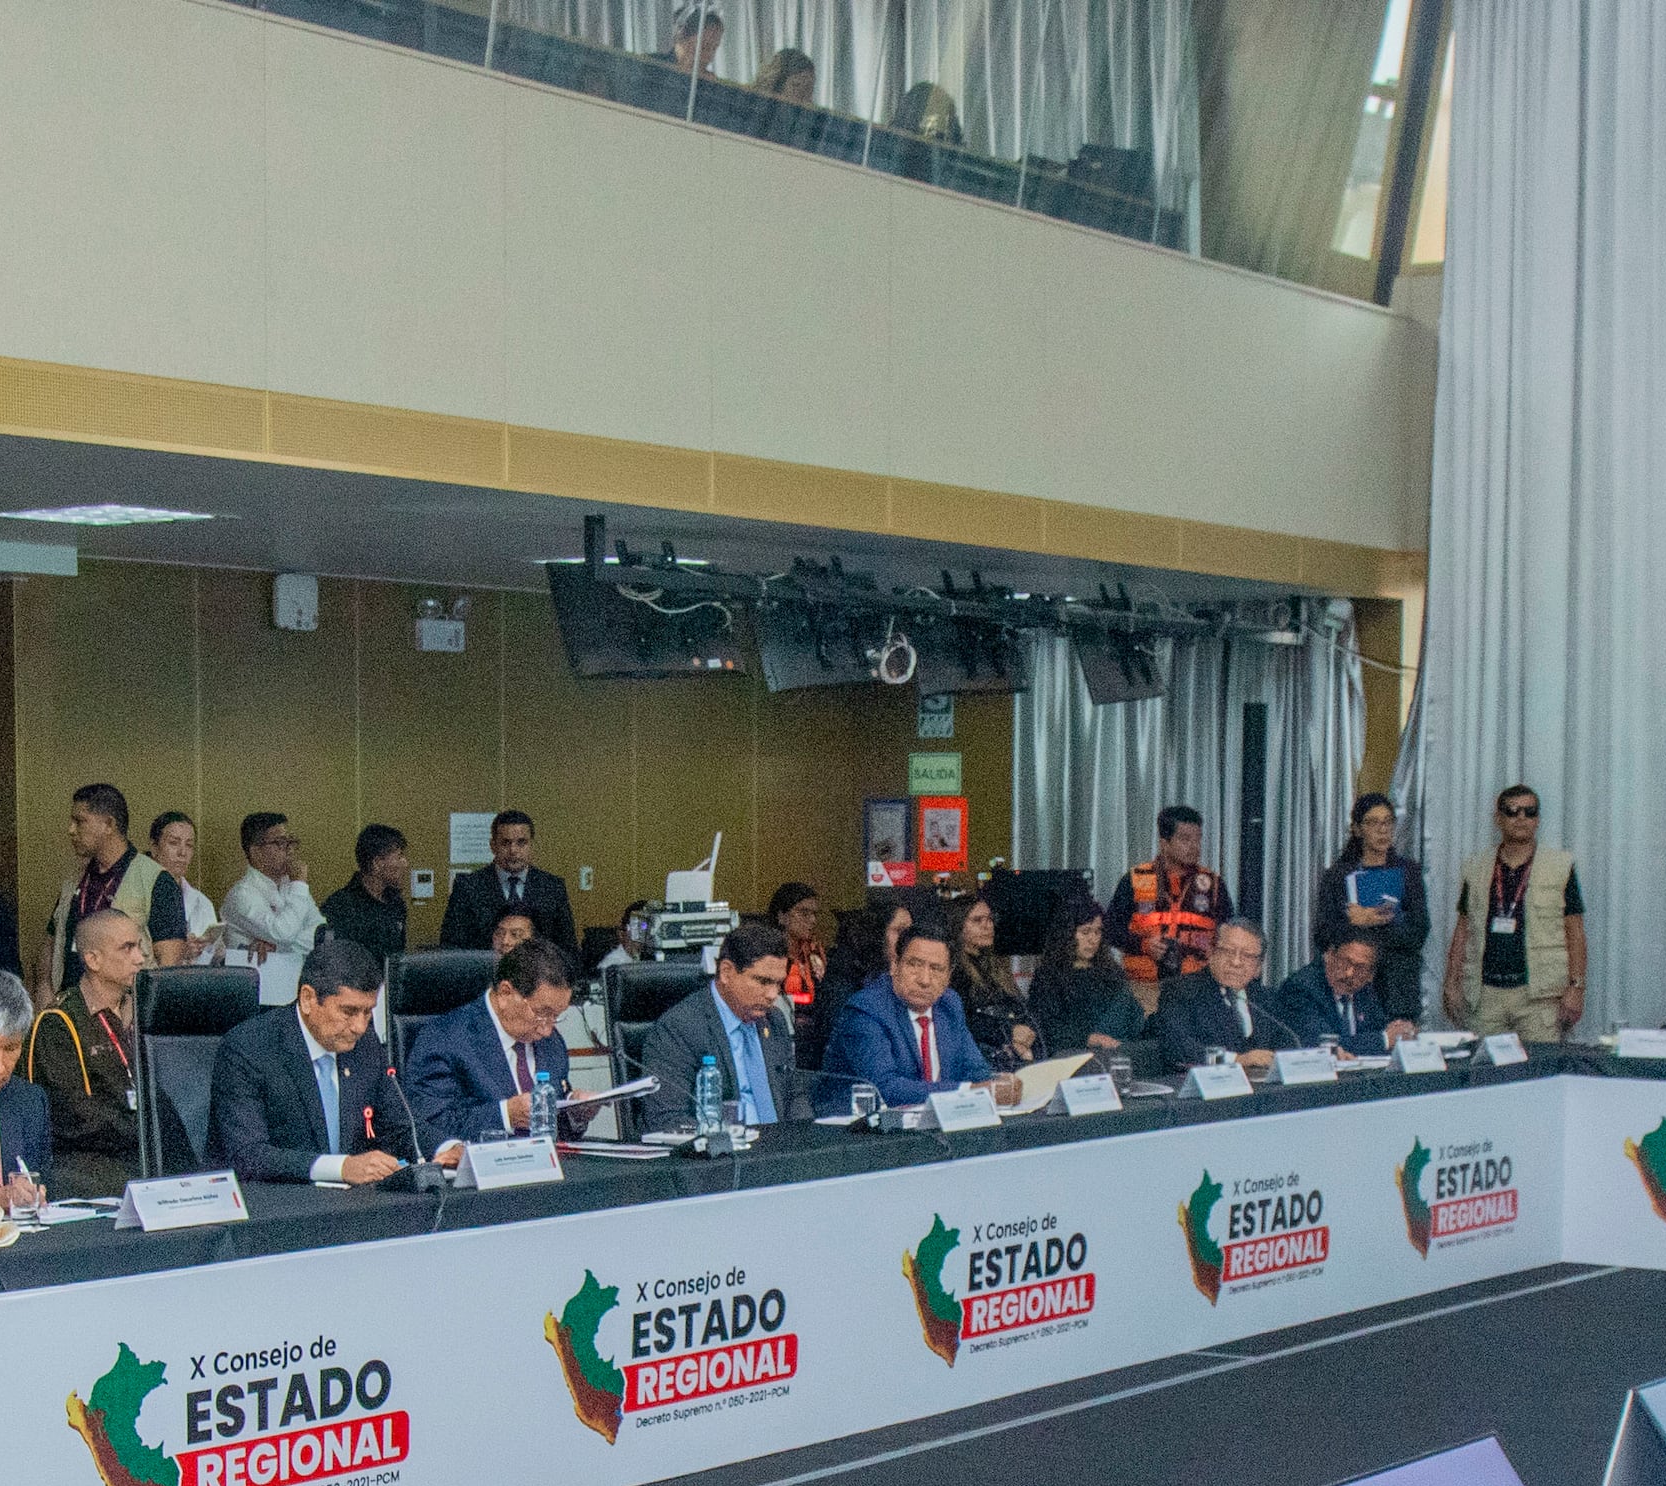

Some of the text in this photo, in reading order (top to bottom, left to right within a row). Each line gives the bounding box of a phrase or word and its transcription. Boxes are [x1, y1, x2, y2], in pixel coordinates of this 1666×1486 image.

[913, 767, 956, 780] SALIDA
[1436, 1155, 1512, 1200] ESTADO
[973, 1212, 1057, 1244] X Consejo de
[1229, 1189, 1324, 1240] ESTADO
[1438, 1191, 1516, 1235] REGIONAL
[968, 1232, 1087, 1292] ESTADO
[1232, 1229, 1326, 1277] REGIONAL
[636, 1267, 745, 1303] X Consejo de
[970, 1276, 1090, 1334] REGIONAL
[632, 1288, 786, 1359] ESTADO
[190, 1334, 336, 1380] X Consejo de
[637, 1340, 791, 1405] REGIONAL
[186, 1359, 392, 1446] ESTADO
[636, 1411, 671, 1429] Decreto
[673, 1402, 713, 1423] Supremo
